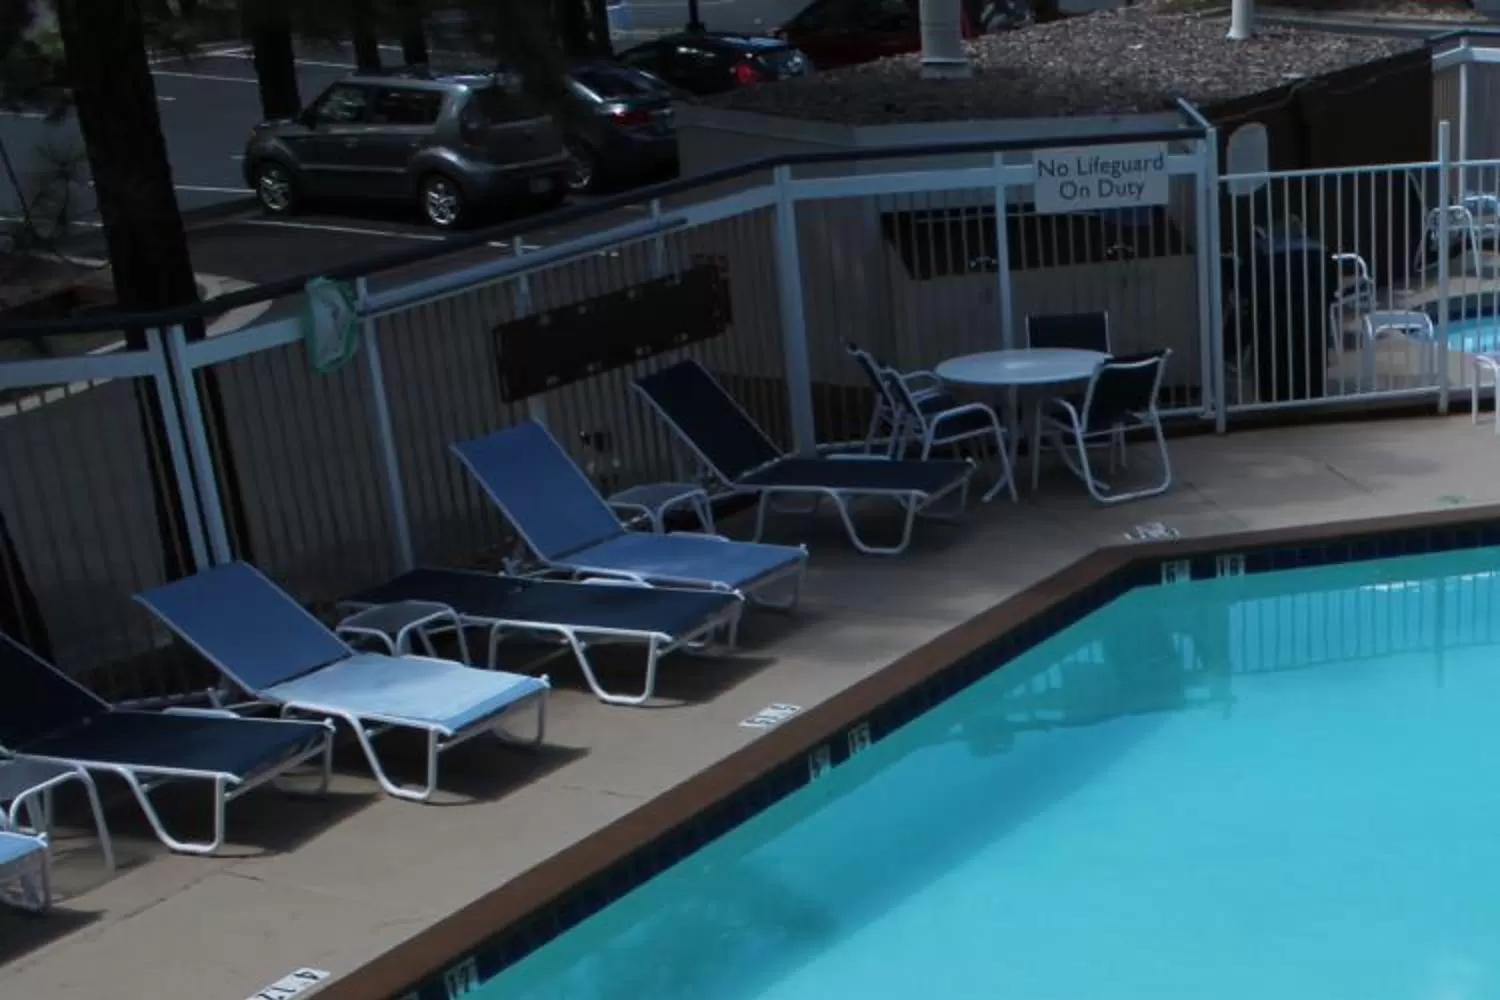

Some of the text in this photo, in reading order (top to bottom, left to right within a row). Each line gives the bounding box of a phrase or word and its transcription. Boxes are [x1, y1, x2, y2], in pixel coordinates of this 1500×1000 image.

[1037, 152, 1164, 178] No Lifeguard
[1059, 178, 1145, 200] On Duty
